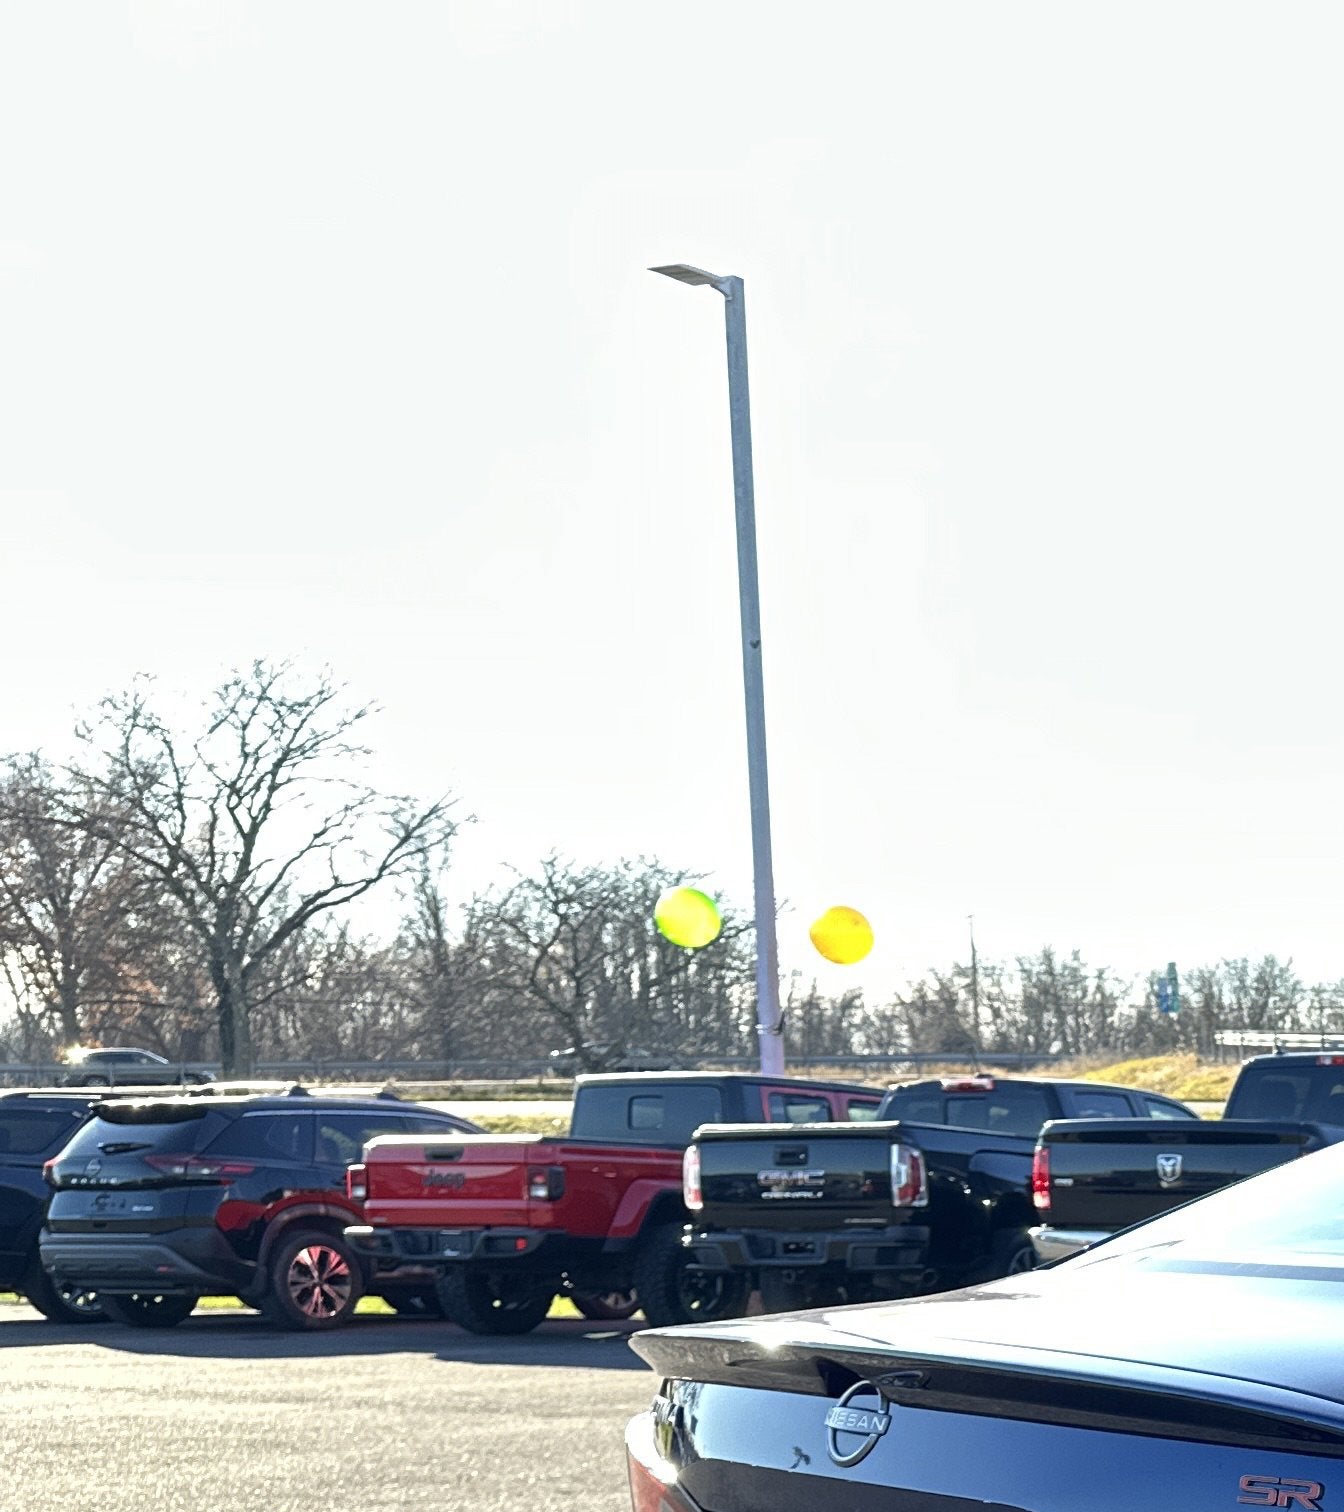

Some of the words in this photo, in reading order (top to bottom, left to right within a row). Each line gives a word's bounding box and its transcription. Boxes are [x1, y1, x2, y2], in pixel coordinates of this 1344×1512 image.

[422, 1167, 465, 1190] Jeep
[757, 1169, 825, 1186] GMC
[1236, 1474, 1322, 1511] SR
